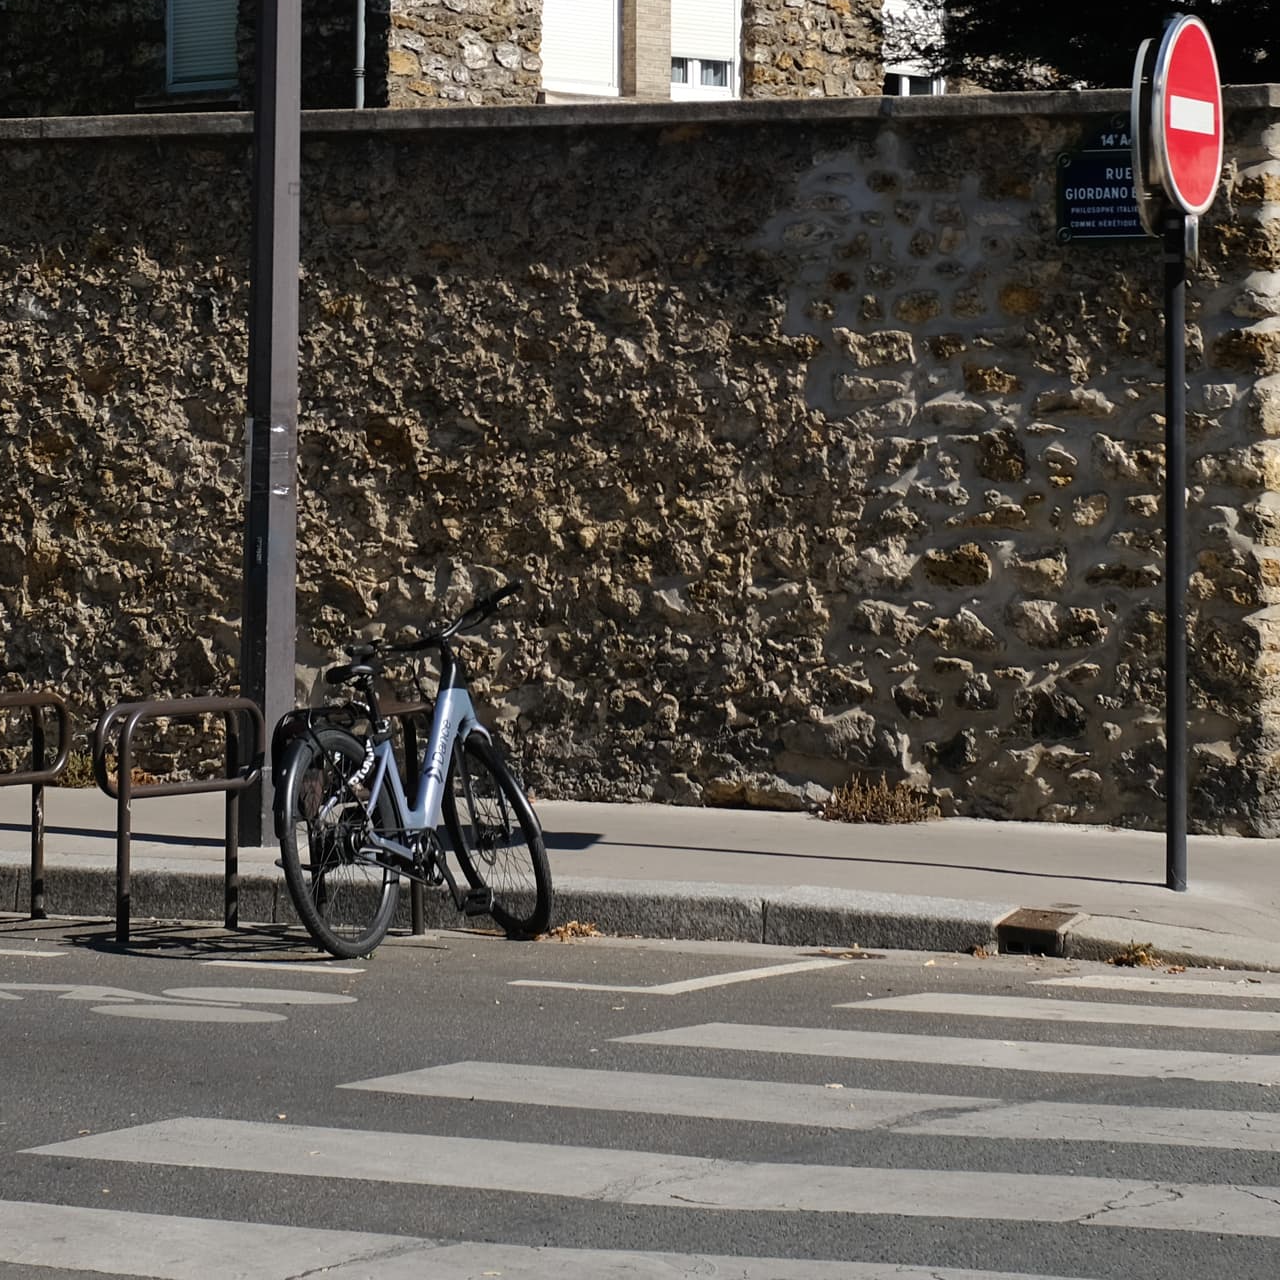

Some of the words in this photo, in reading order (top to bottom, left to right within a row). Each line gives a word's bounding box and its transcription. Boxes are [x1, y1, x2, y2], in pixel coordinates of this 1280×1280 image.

[1105, 167, 1133, 181] RUE
[1065, 187, 1128, 200] GIORDANO
[1071, 206, 1115, 214] PHILOSOPHE
[1117, 205, 1138, 213] ITALIE
[1070, 220, 1096, 228] COMME
[431, 719, 451, 765] Dance
